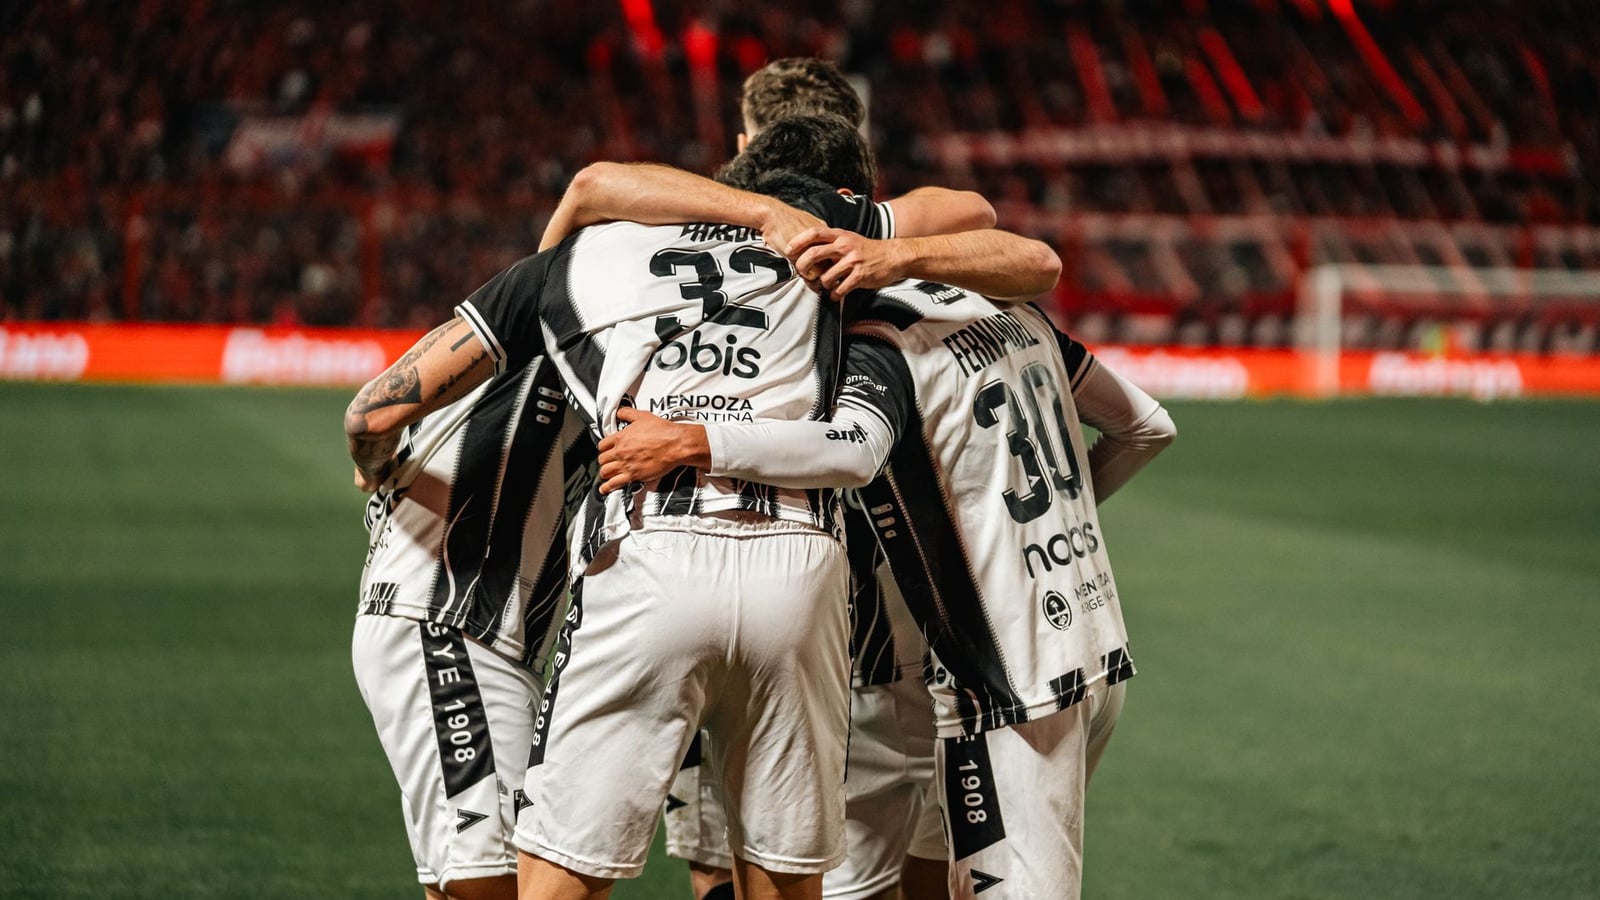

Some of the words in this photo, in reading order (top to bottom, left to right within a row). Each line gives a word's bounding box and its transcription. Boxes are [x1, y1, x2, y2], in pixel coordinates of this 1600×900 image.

[649, 246, 795, 341] 32
[644, 330, 761, 378] obis
[649, 394, 754, 412] MENDOZA
[659, 410, 754, 423] RGENTINA
[973, 361, 1083, 522] 30
[1074, 572, 1111, 600] MENZA
[444, 699, 476, 762] 1908
[958, 760, 987, 823] 1908
